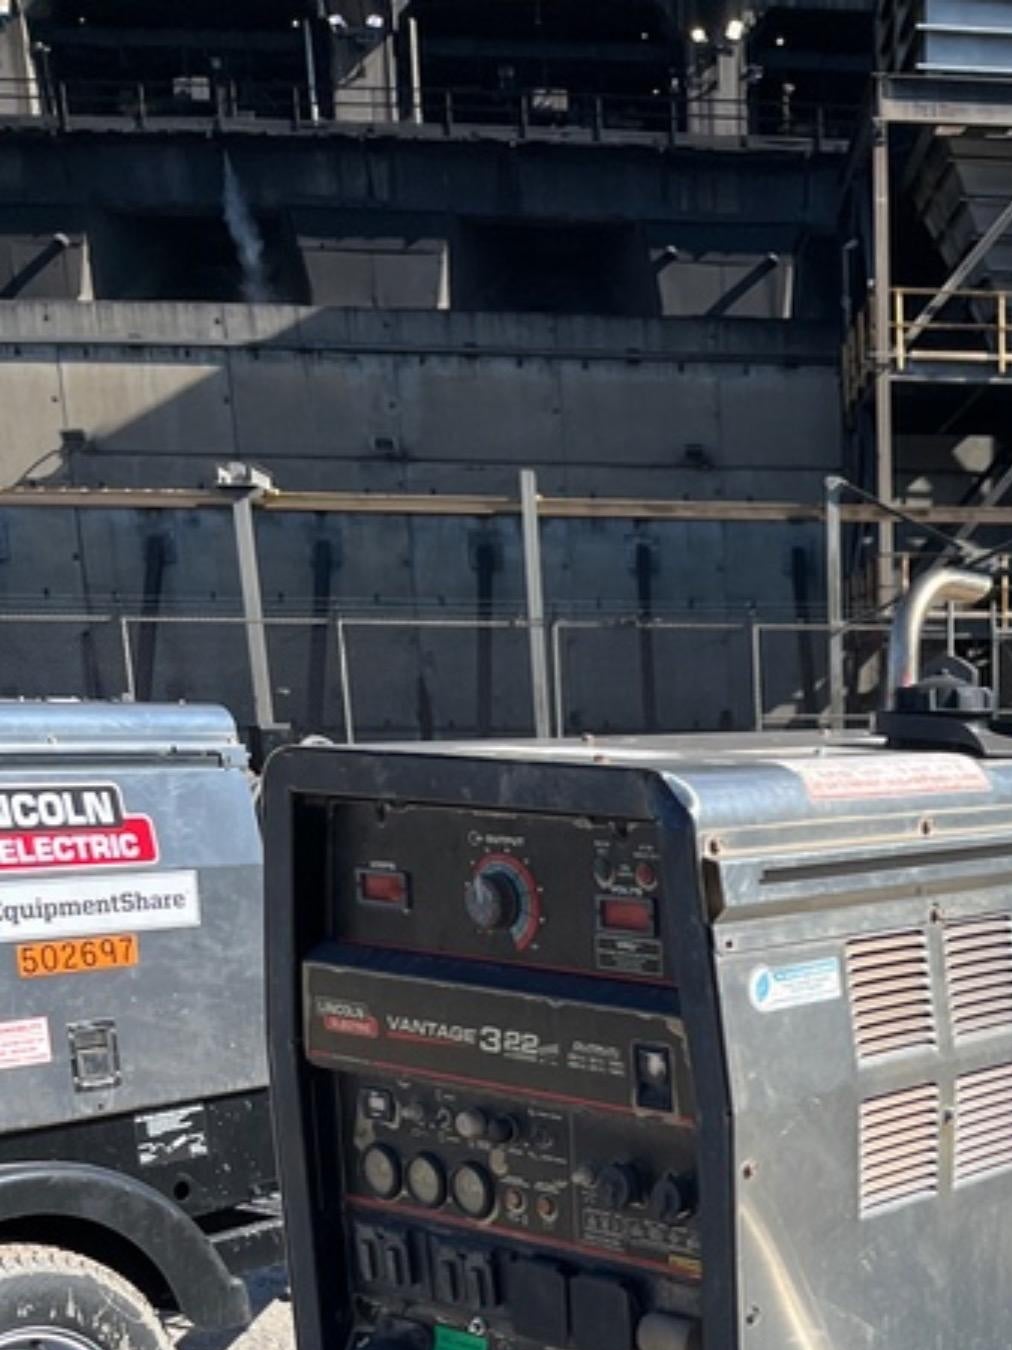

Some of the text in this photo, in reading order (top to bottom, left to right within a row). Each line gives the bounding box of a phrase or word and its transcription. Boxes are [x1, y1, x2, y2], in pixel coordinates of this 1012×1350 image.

[0, 891, 186, 925] quipmentShare
[21, 934, 133, 974] 502697
[386, 1013, 477, 1045] VANTAGE
